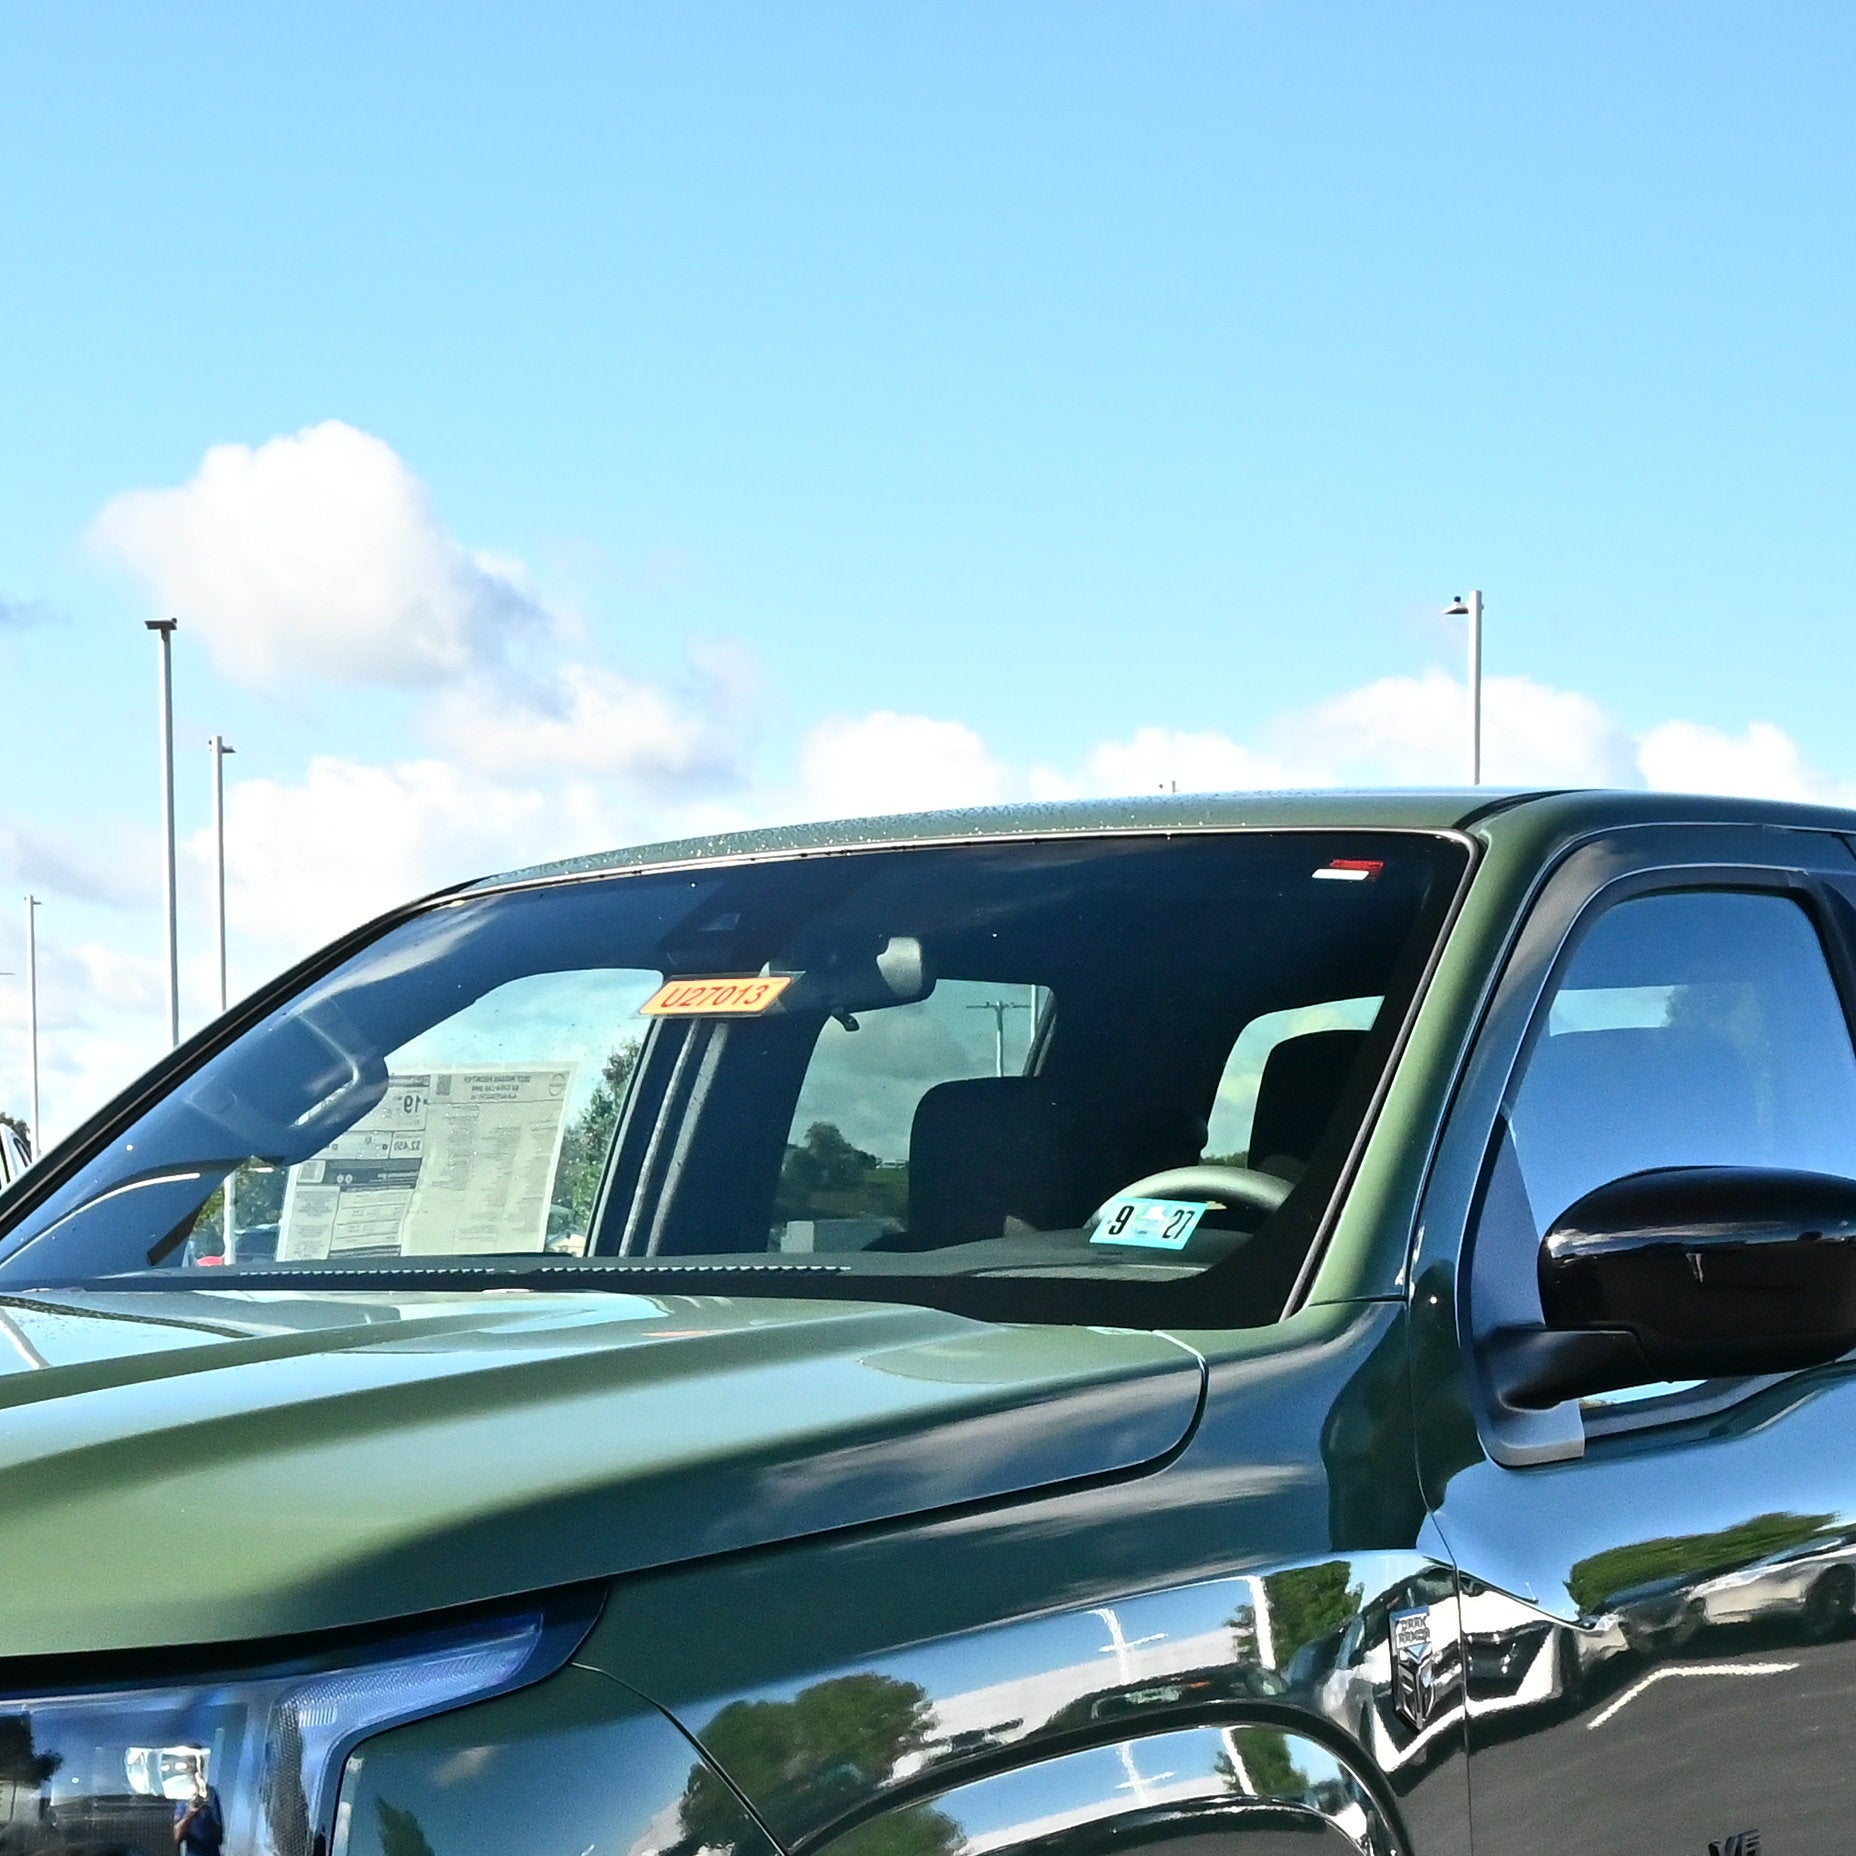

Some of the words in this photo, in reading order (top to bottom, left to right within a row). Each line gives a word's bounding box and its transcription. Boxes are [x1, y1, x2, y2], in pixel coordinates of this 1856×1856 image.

[660, 984, 769, 1008] U27013
[1108, 1205, 1135, 1235] 9
[1162, 1209, 1196, 1240] 27
